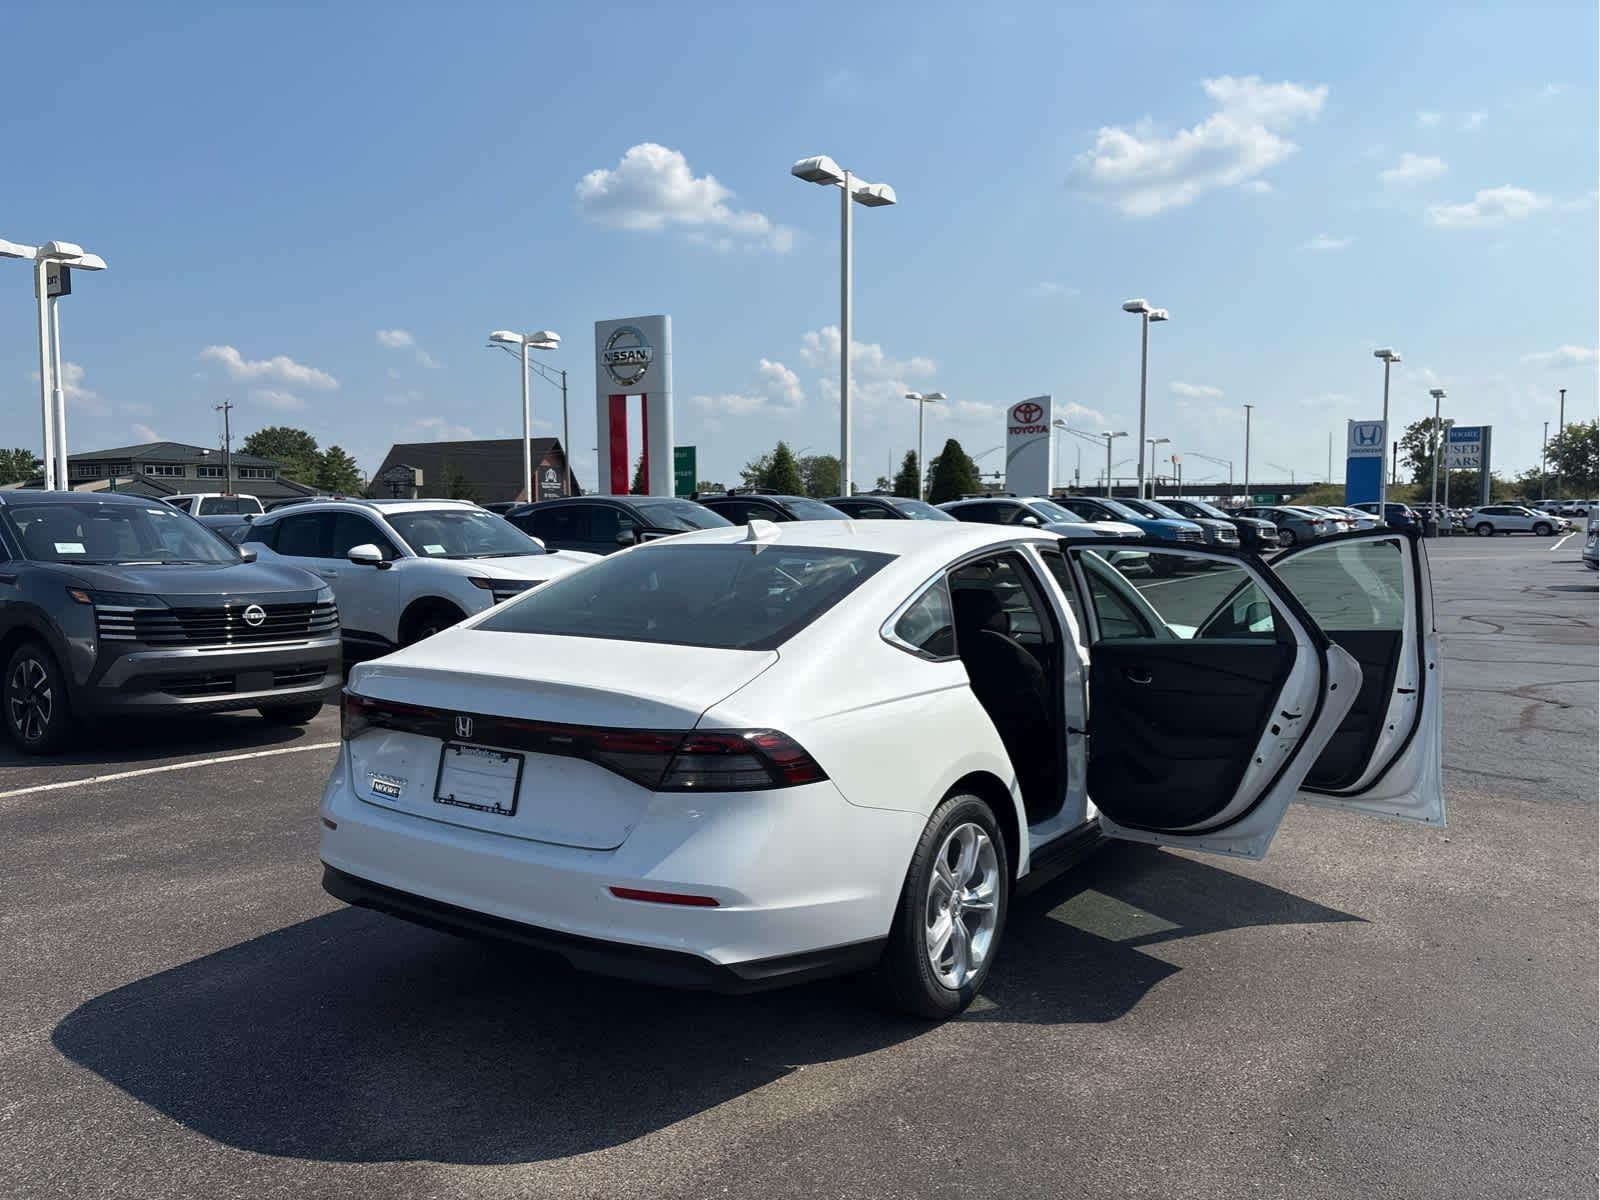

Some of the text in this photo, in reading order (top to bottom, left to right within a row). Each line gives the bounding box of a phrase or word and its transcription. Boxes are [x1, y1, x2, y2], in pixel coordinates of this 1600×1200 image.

[604, 350, 646, 361] NISSAN
[1008, 425, 1048, 434] TOYOTA
[375, 783, 399, 795] MOORE
